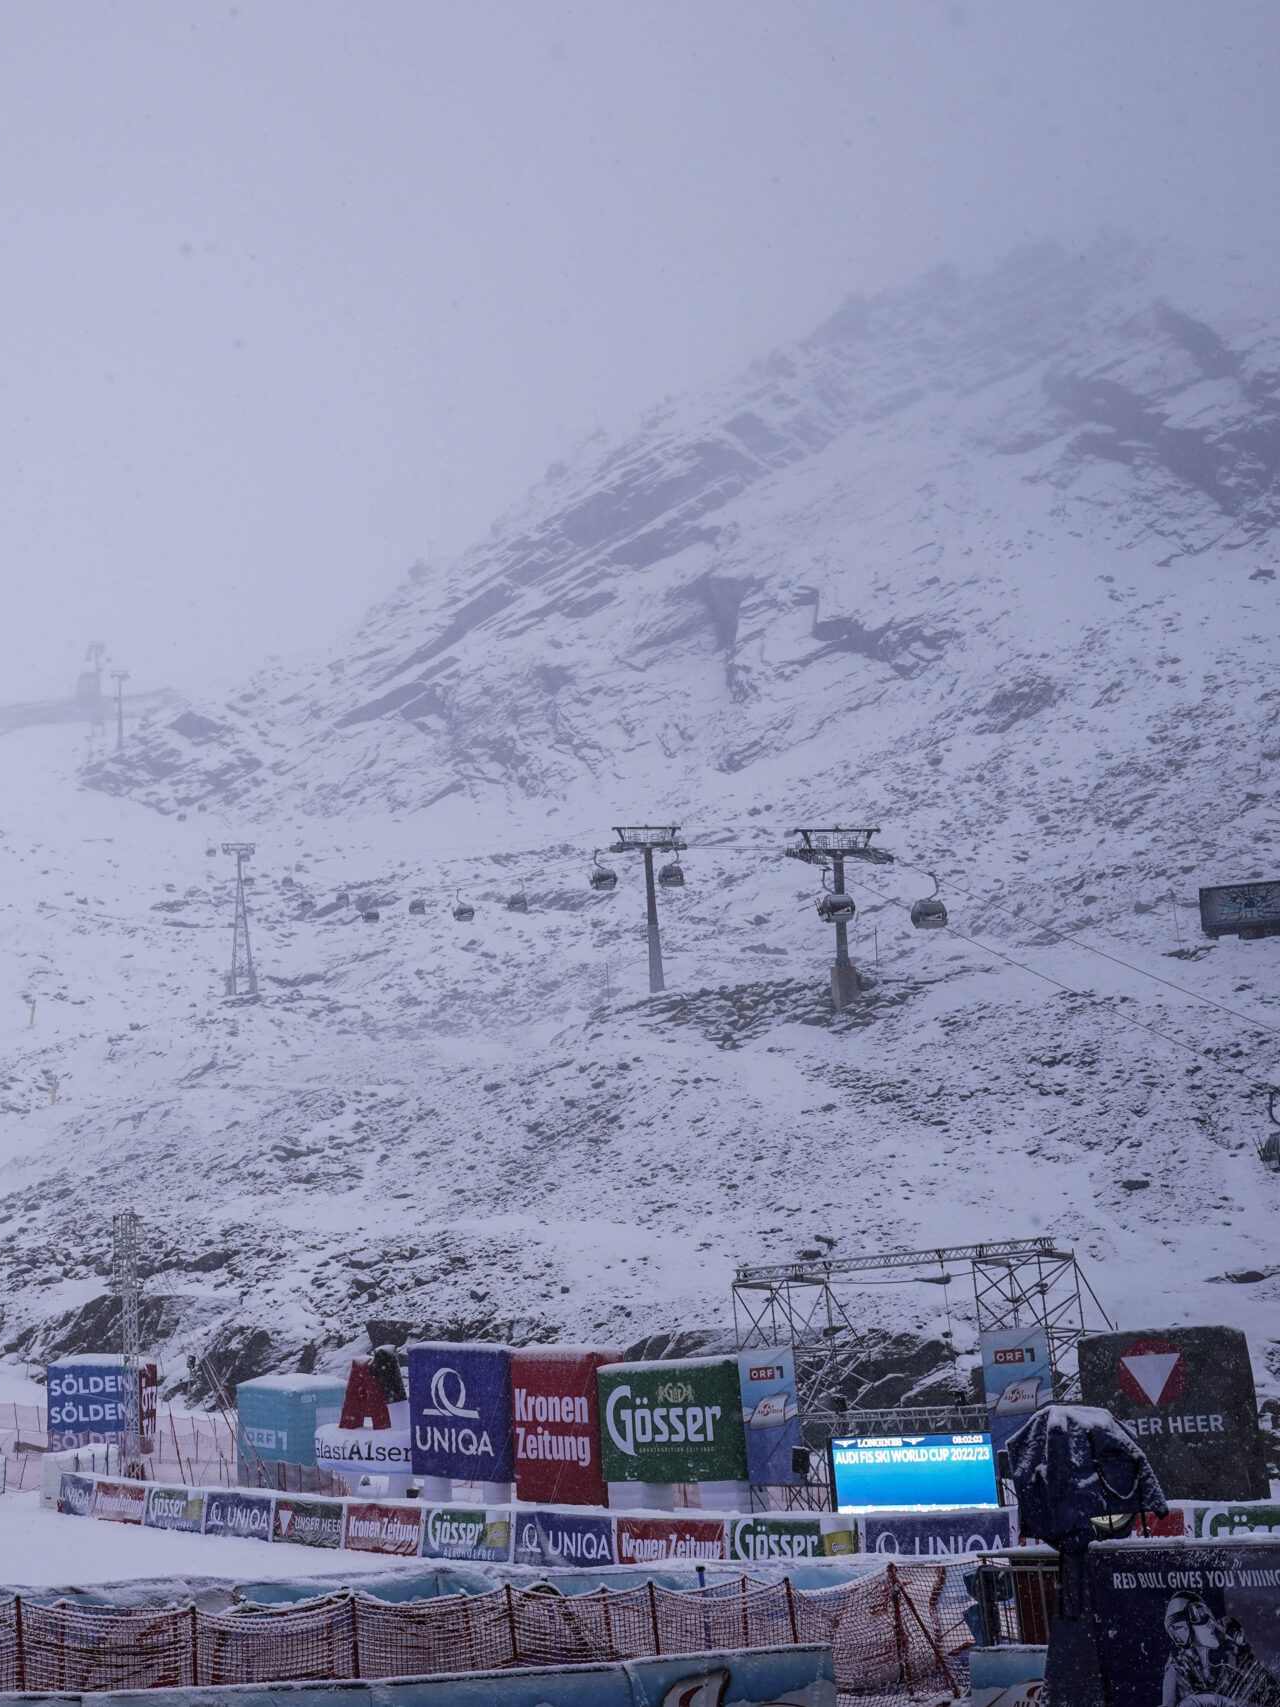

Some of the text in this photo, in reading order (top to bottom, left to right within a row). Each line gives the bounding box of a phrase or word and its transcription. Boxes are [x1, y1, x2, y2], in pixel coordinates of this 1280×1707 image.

[996, 1351, 1022, 1362] ORF
[751, 1369, 773, 1378] ORF
[514, 1388, 588, 1423] Kronen
[605, 1385, 721, 1456] Gösser
[1168, 1414, 1224, 1433] HEER
[415, 1426, 495, 1457] UNIQA
[516, 1426, 592, 1467] Zeitung
[835, 1447, 990, 1464] AUDI FIS SKI WORLD CUP 2022/23
[857, 1438, 903, 1448] LONGINES
[61, 1485, 90, 1505] UNIQA
[150, 1487, 187, 1521] Gösser
[227, 1508, 270, 1530] UNIQA
[294, 1516, 341, 1533] UNSER HEER
[349, 1515, 420, 1545] Kronen Zeitung
[427, 1508, 484, 1550] Gösser
[548, 1530, 612, 1560] UNIQA
[622, 1532, 721, 1561] Kronen Zeitung
[734, 1519, 819, 1560] Gösser
[1113, 1573, 1136, 1589] RED
[1137, 1572, 1166, 1588] BULL
[1168, 1571, 1203, 1588] GIVES
[1205, 1571, 1234, 1587] YOU
